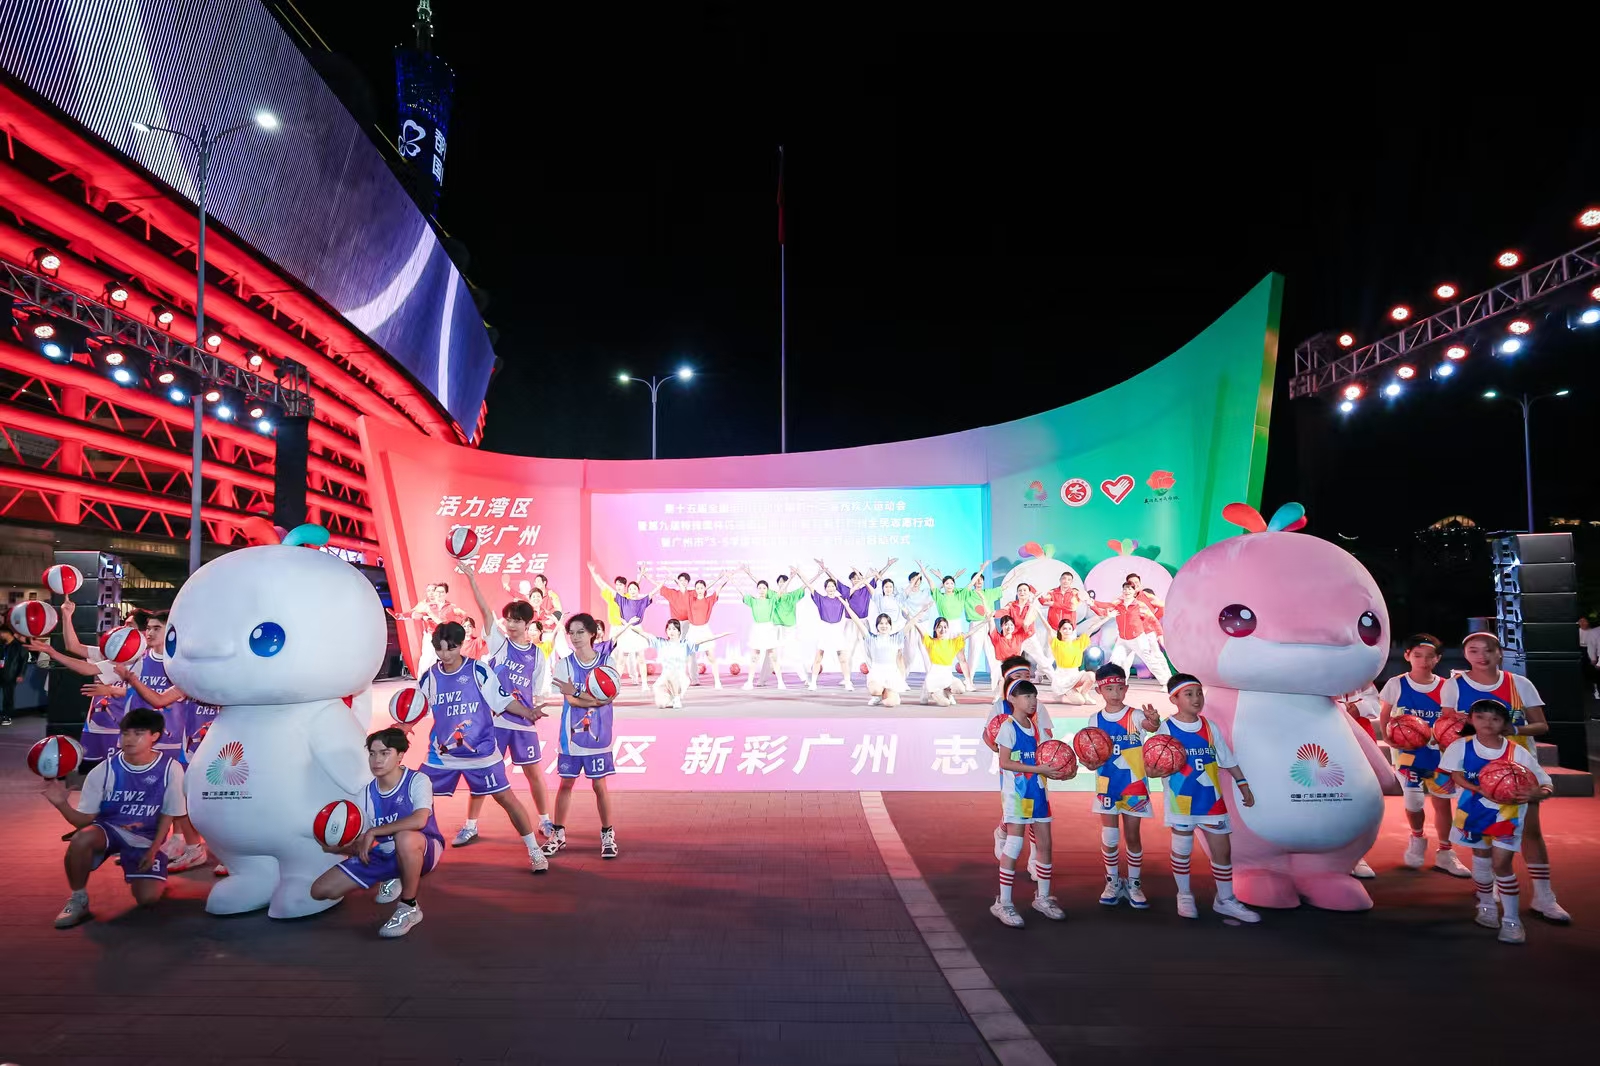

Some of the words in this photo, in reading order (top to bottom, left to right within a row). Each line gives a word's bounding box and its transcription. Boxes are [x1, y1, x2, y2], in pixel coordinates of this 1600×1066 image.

[436, 495, 534, 518] 活力湾区
[449, 524, 542, 547] 彩广州
[446, 702, 480, 718] CREW
[526, 745, 536, 759] 3
[680, 733, 898, 776] 新彩广州
[1113, 744, 1121, 756] 8
[591, 758, 605, 772] 13
[1194, 758, 1205, 771] 6
[484, 772, 499, 788] 11
[1103, 796, 1112, 808] 8
[119, 804, 161, 817] CREW
